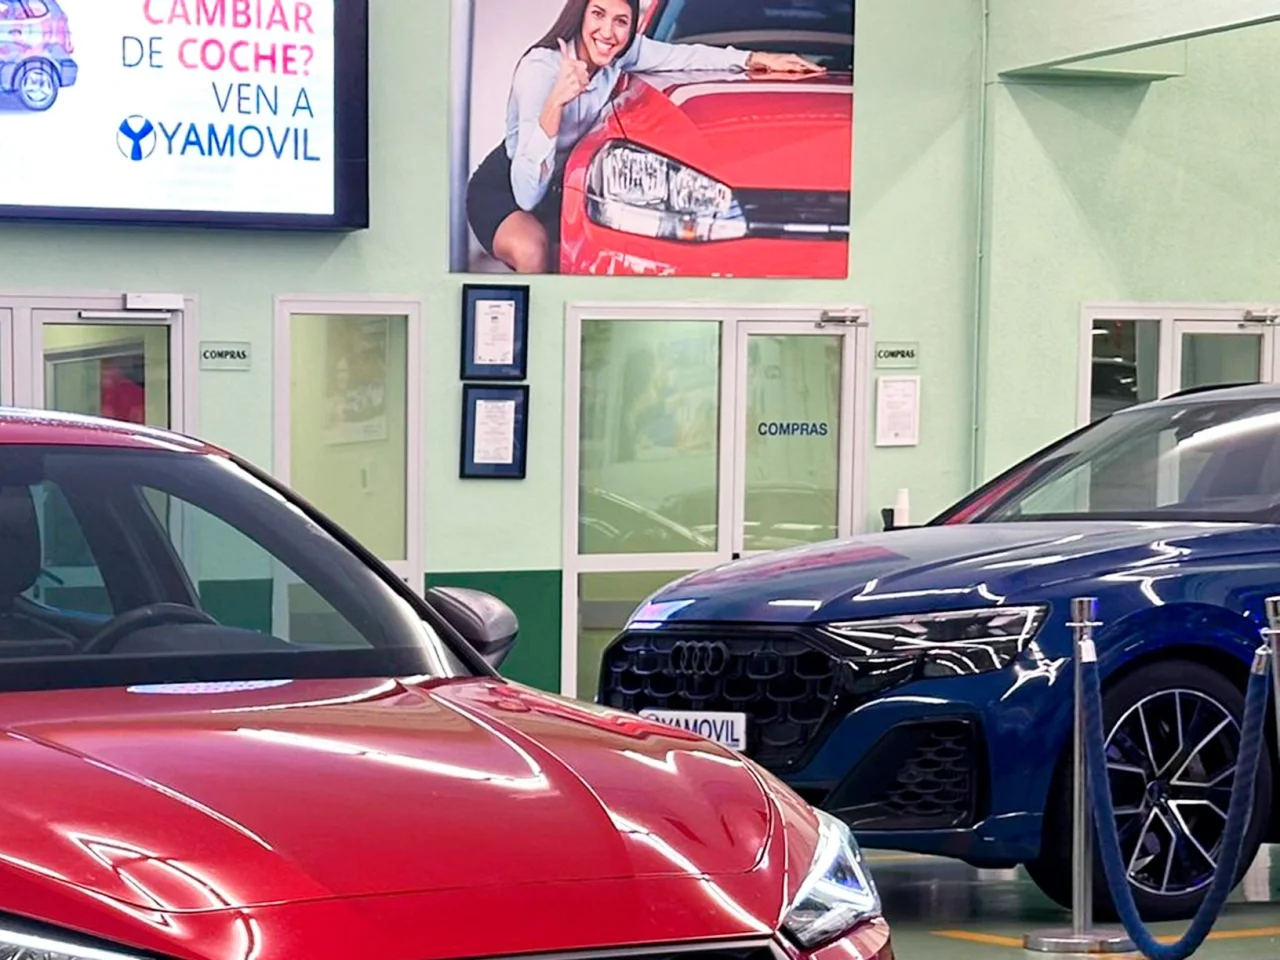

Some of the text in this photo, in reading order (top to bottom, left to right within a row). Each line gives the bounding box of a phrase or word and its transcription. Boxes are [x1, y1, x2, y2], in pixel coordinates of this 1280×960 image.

[143, 0, 314, 34] CAMBIAR
[122, 35, 314, 77] DE COCHE?
[211, 81, 314, 119] VEN A
[158, 121, 321, 162] YAMOVIL
[202, 350, 247, 360] COMPRAS
[877, 350, 916, 359] COMPRAS
[758, 422, 828, 436] COMPRAS
